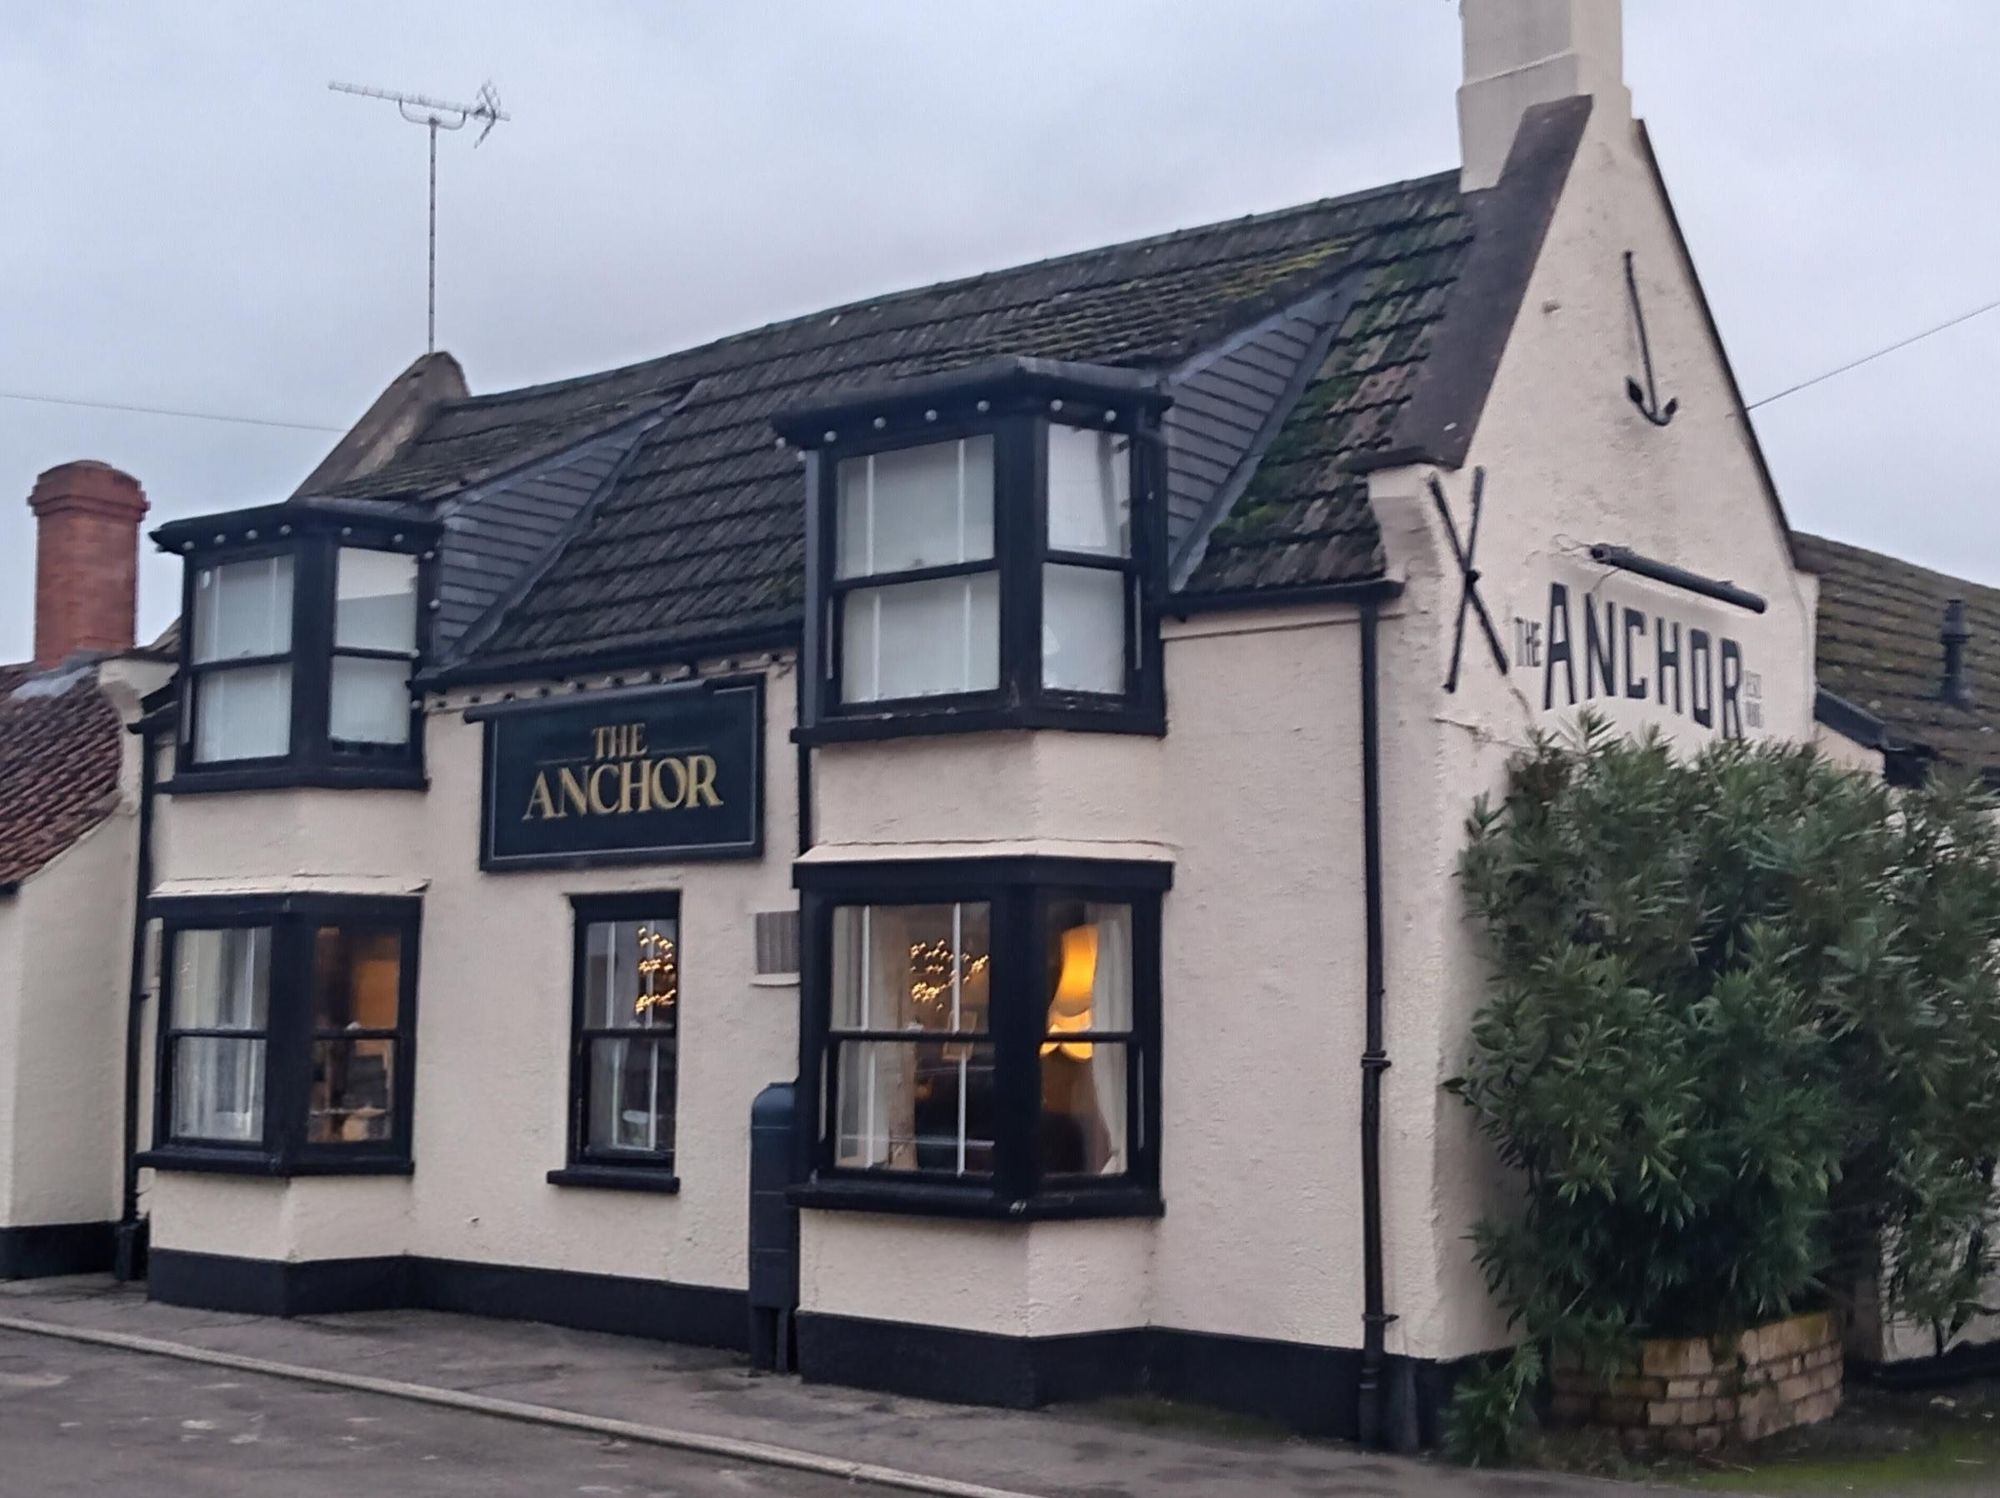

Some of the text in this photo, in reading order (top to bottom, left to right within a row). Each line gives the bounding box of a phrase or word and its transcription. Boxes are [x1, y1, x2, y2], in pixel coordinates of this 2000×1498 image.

[1513, 581, 1742, 747] THE ANCHOR
[592, 722, 648, 760] THE
[521, 754, 724, 821] ANCHOR
